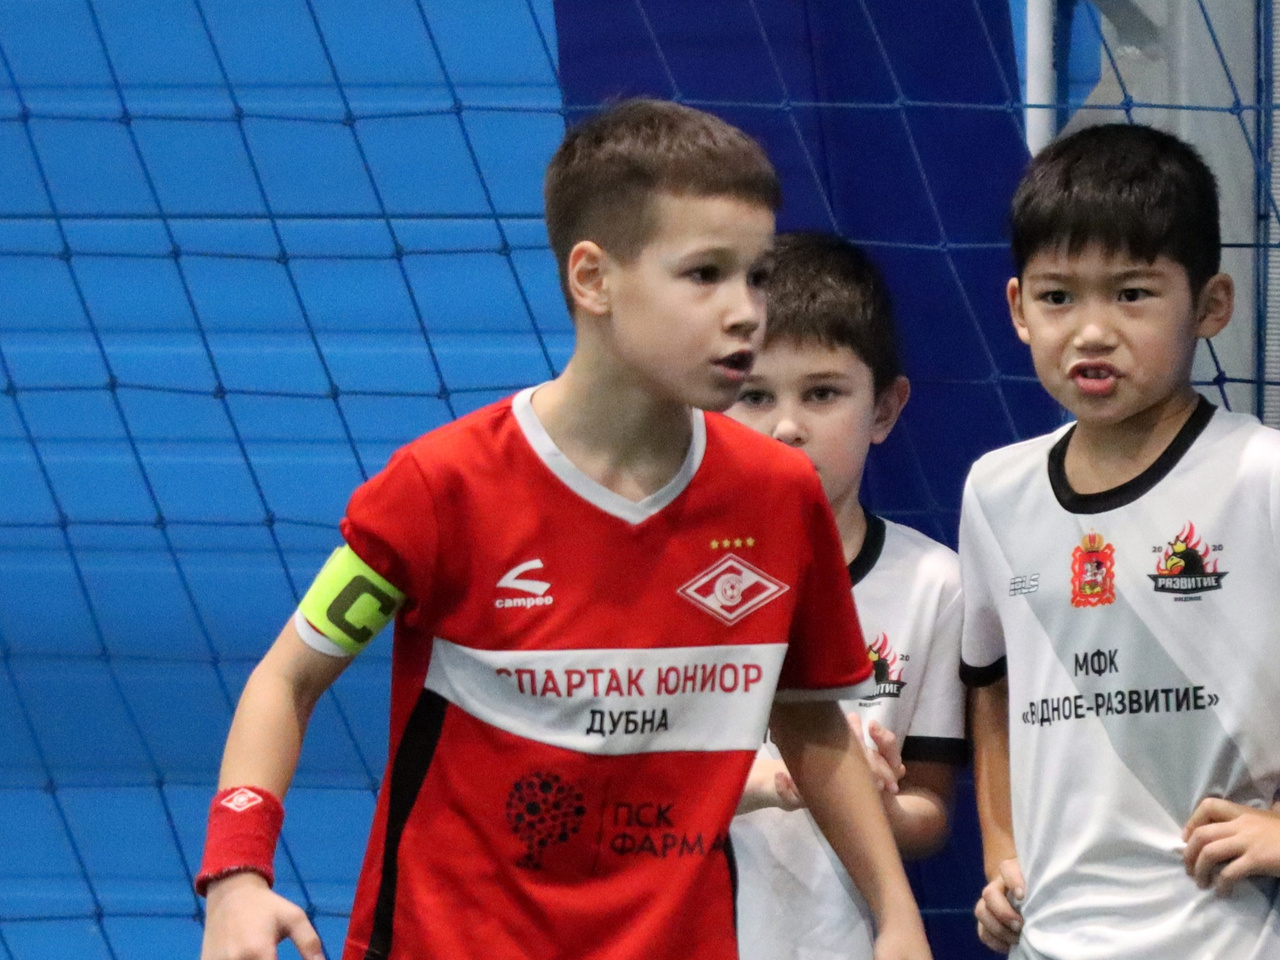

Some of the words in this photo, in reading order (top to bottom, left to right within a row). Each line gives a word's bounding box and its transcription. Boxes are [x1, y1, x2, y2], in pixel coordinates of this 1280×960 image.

[1157, 576, 1218, 590] РАЗВИТИЕ
[327, 575, 397, 643] C
[1073, 649, 1119, 677] МФК
[656, 663, 764, 696] ЮНИОР
[586, 708, 669, 736] ДУБНА
[614, 803, 674, 828] ПСК
